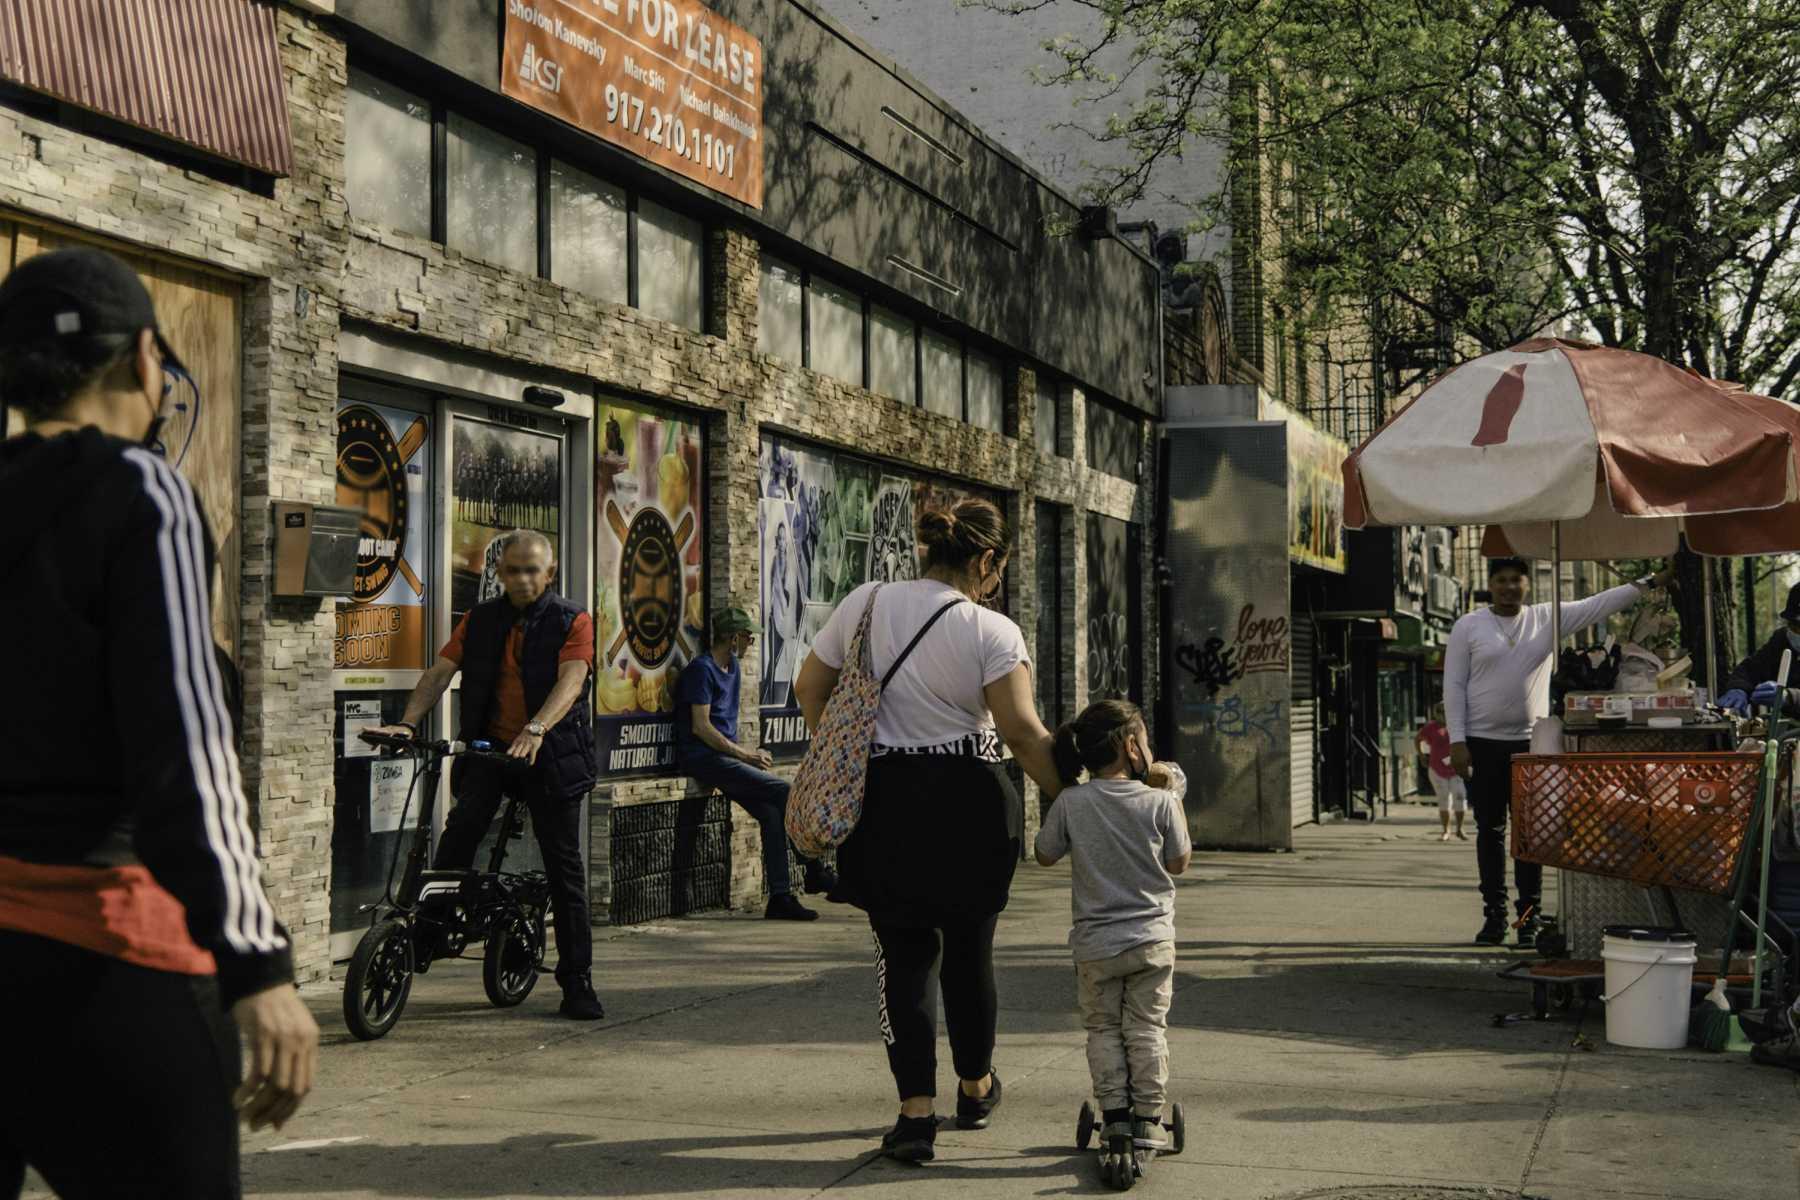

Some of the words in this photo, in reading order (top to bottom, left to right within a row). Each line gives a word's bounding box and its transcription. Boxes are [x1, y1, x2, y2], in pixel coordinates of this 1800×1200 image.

[509, 0, 553, 35] Sholom
[555, 17, 607, 66] Kanevsky
[624, 55, 648, 85] Marc
[685, 13, 755, 95] LEASE
[680, 84, 711, 117] Michael
[335, 606, 400, 640] OMING
[1235, 604, 1288, 643] love
[345, 703, 361, 713] NYC
[609, 746, 660, 770] NATURAL
